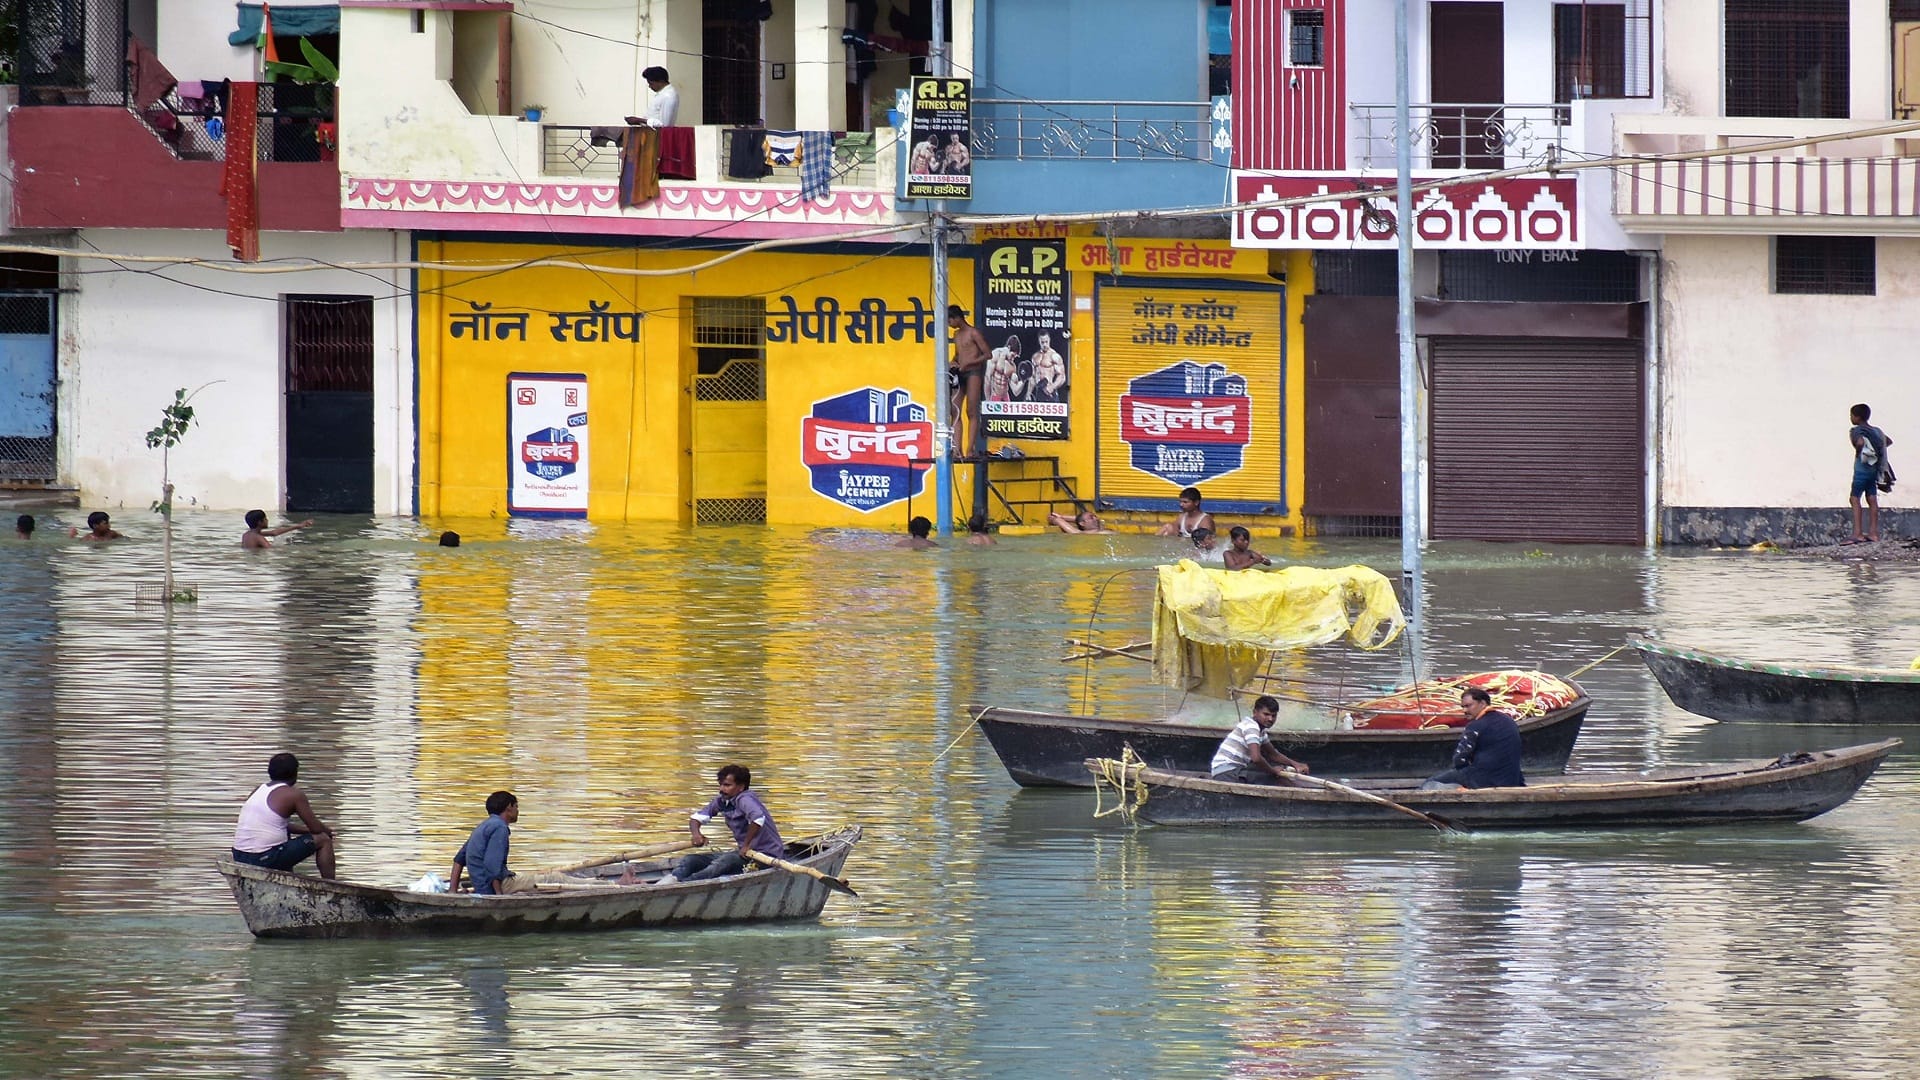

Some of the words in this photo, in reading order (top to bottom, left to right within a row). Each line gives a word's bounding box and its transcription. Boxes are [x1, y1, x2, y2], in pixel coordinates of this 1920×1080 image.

[918, 81, 966, 99] A.P.
[917, 100, 948, 110] FITNESS
[950, 101, 967, 110] GYM
[990, 246, 1061, 277] A.P.
[1144, 241, 1237, 271] हार्डवेयर
[1494, 249, 1534, 264] TONY
[988, 278, 1034, 295] FITNESS
[1036, 279, 1062, 295] GYM
[985, 307, 1007, 318] Morning
[1034, 309, 1041, 317] to
[1055, 310, 1064, 318] am
[1133, 296, 1176, 319] नॉन
[1181, 298, 1238, 321] स्टॉप
[449, 302, 530, 341] नॉन
[549, 301, 643, 343] स्टॉप
[766, 295, 841, 344] जेपी
[844, 296, 969, 344] सीमे
[985, 318, 1007, 328] Evening
[1011, 318, 1023, 327] 4:00
[1024, 320, 1034, 329] pm
[1034, 319, 1041, 328] to
[1054, 321, 1064, 330] pm
[1132, 322, 1179, 345] जेपी
[1002, 403, 1065, 415] 8115983558
[986, 419, 1015, 433] आशा
[1131, 400, 1237, 436] बुलंद
[815, 425, 921, 460] बुलंद
[526, 442, 574, 461] बुलंद
[1163, 461, 1205, 472] CEMENT
[846, 487, 890, 498] CEMENT
